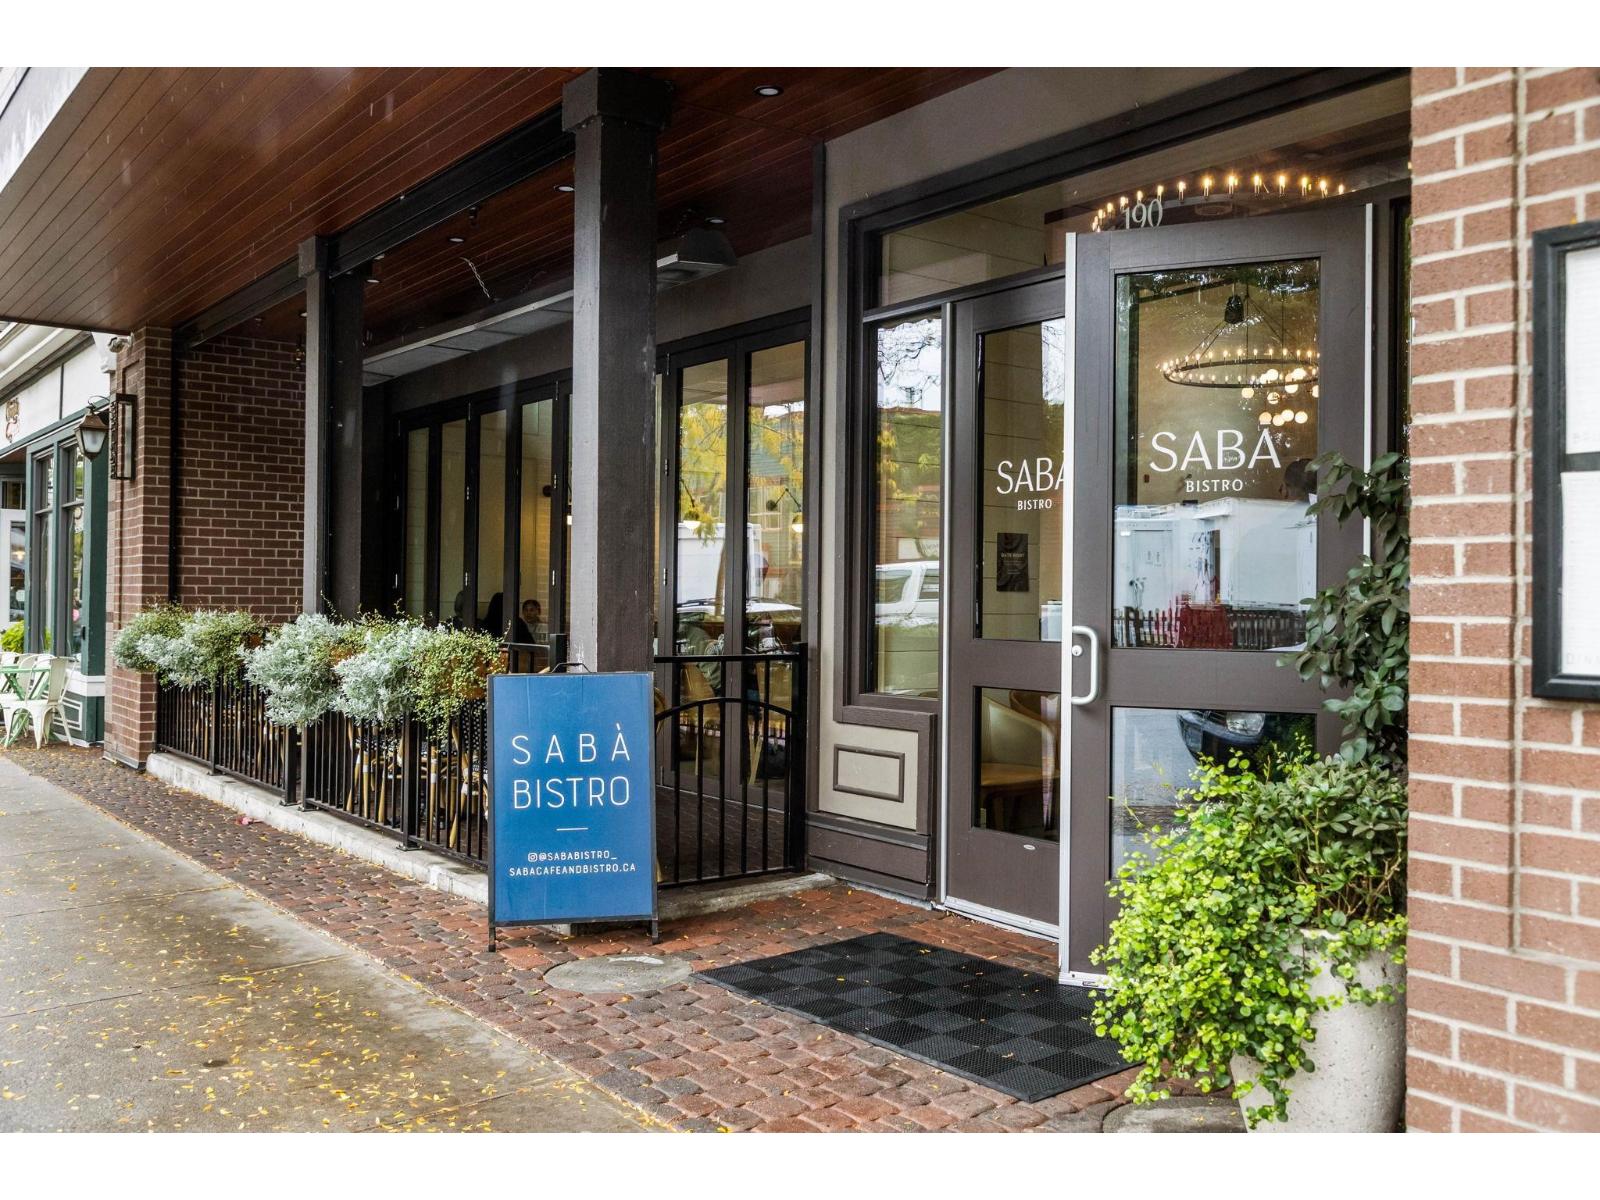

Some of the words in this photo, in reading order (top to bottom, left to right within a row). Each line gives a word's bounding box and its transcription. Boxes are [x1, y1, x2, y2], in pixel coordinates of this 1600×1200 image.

[1120, 198, 1163, 230] 190
[1185, 479, 1243, 493] BISTRO
[1017, 498, 1053, 511] BISTRO
[511, 722, 631, 765] SABÀ
[513, 775, 630, 809] BISTRO
[509, 863, 636, 877] SABACAFEANDBISTRO.CA
